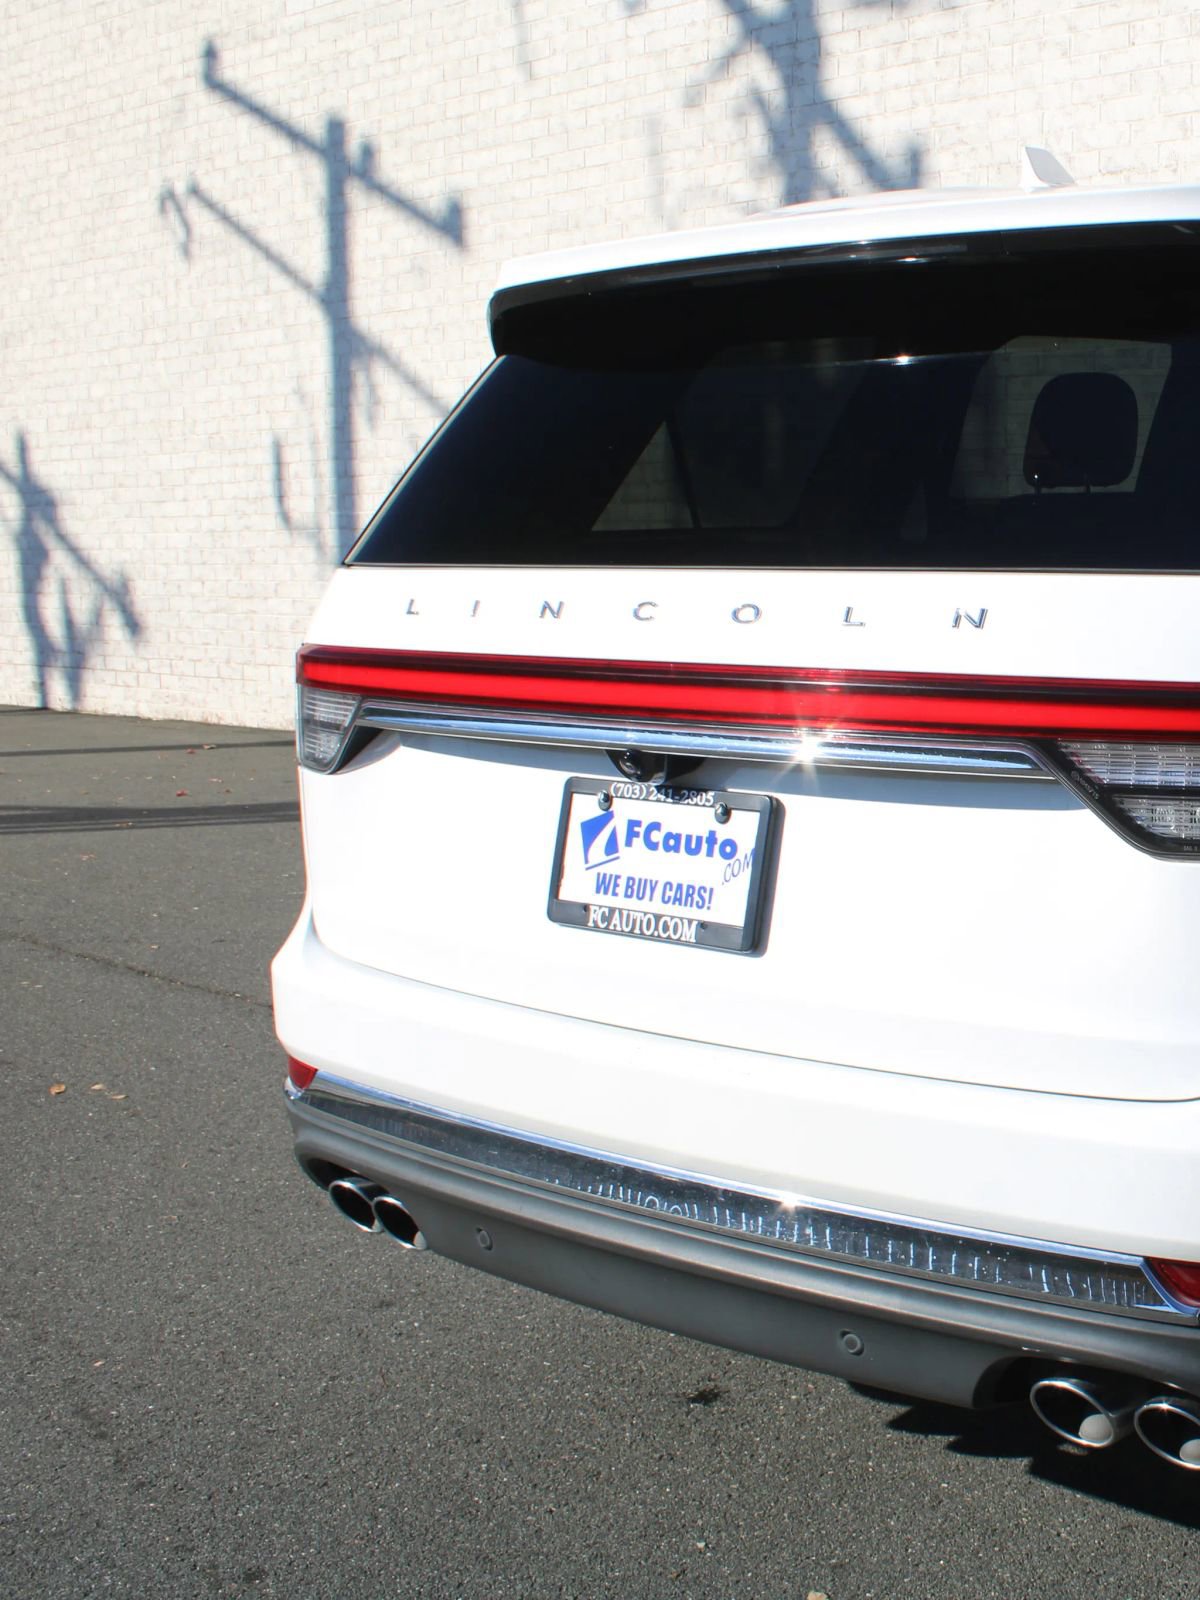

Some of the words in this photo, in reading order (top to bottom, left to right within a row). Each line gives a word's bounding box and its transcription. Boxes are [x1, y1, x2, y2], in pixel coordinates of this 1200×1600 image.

[406, 598, 989, 630] LINCOLN
[610, 782, 648, 800] (703)
[648, 784, 715, 806] 241-2805
[624, 818, 738, 861] FCauto
[595, 872, 622, 897] WE
[623, 876, 659, 902] BUY
[661, 881, 714, 911] CARS!
